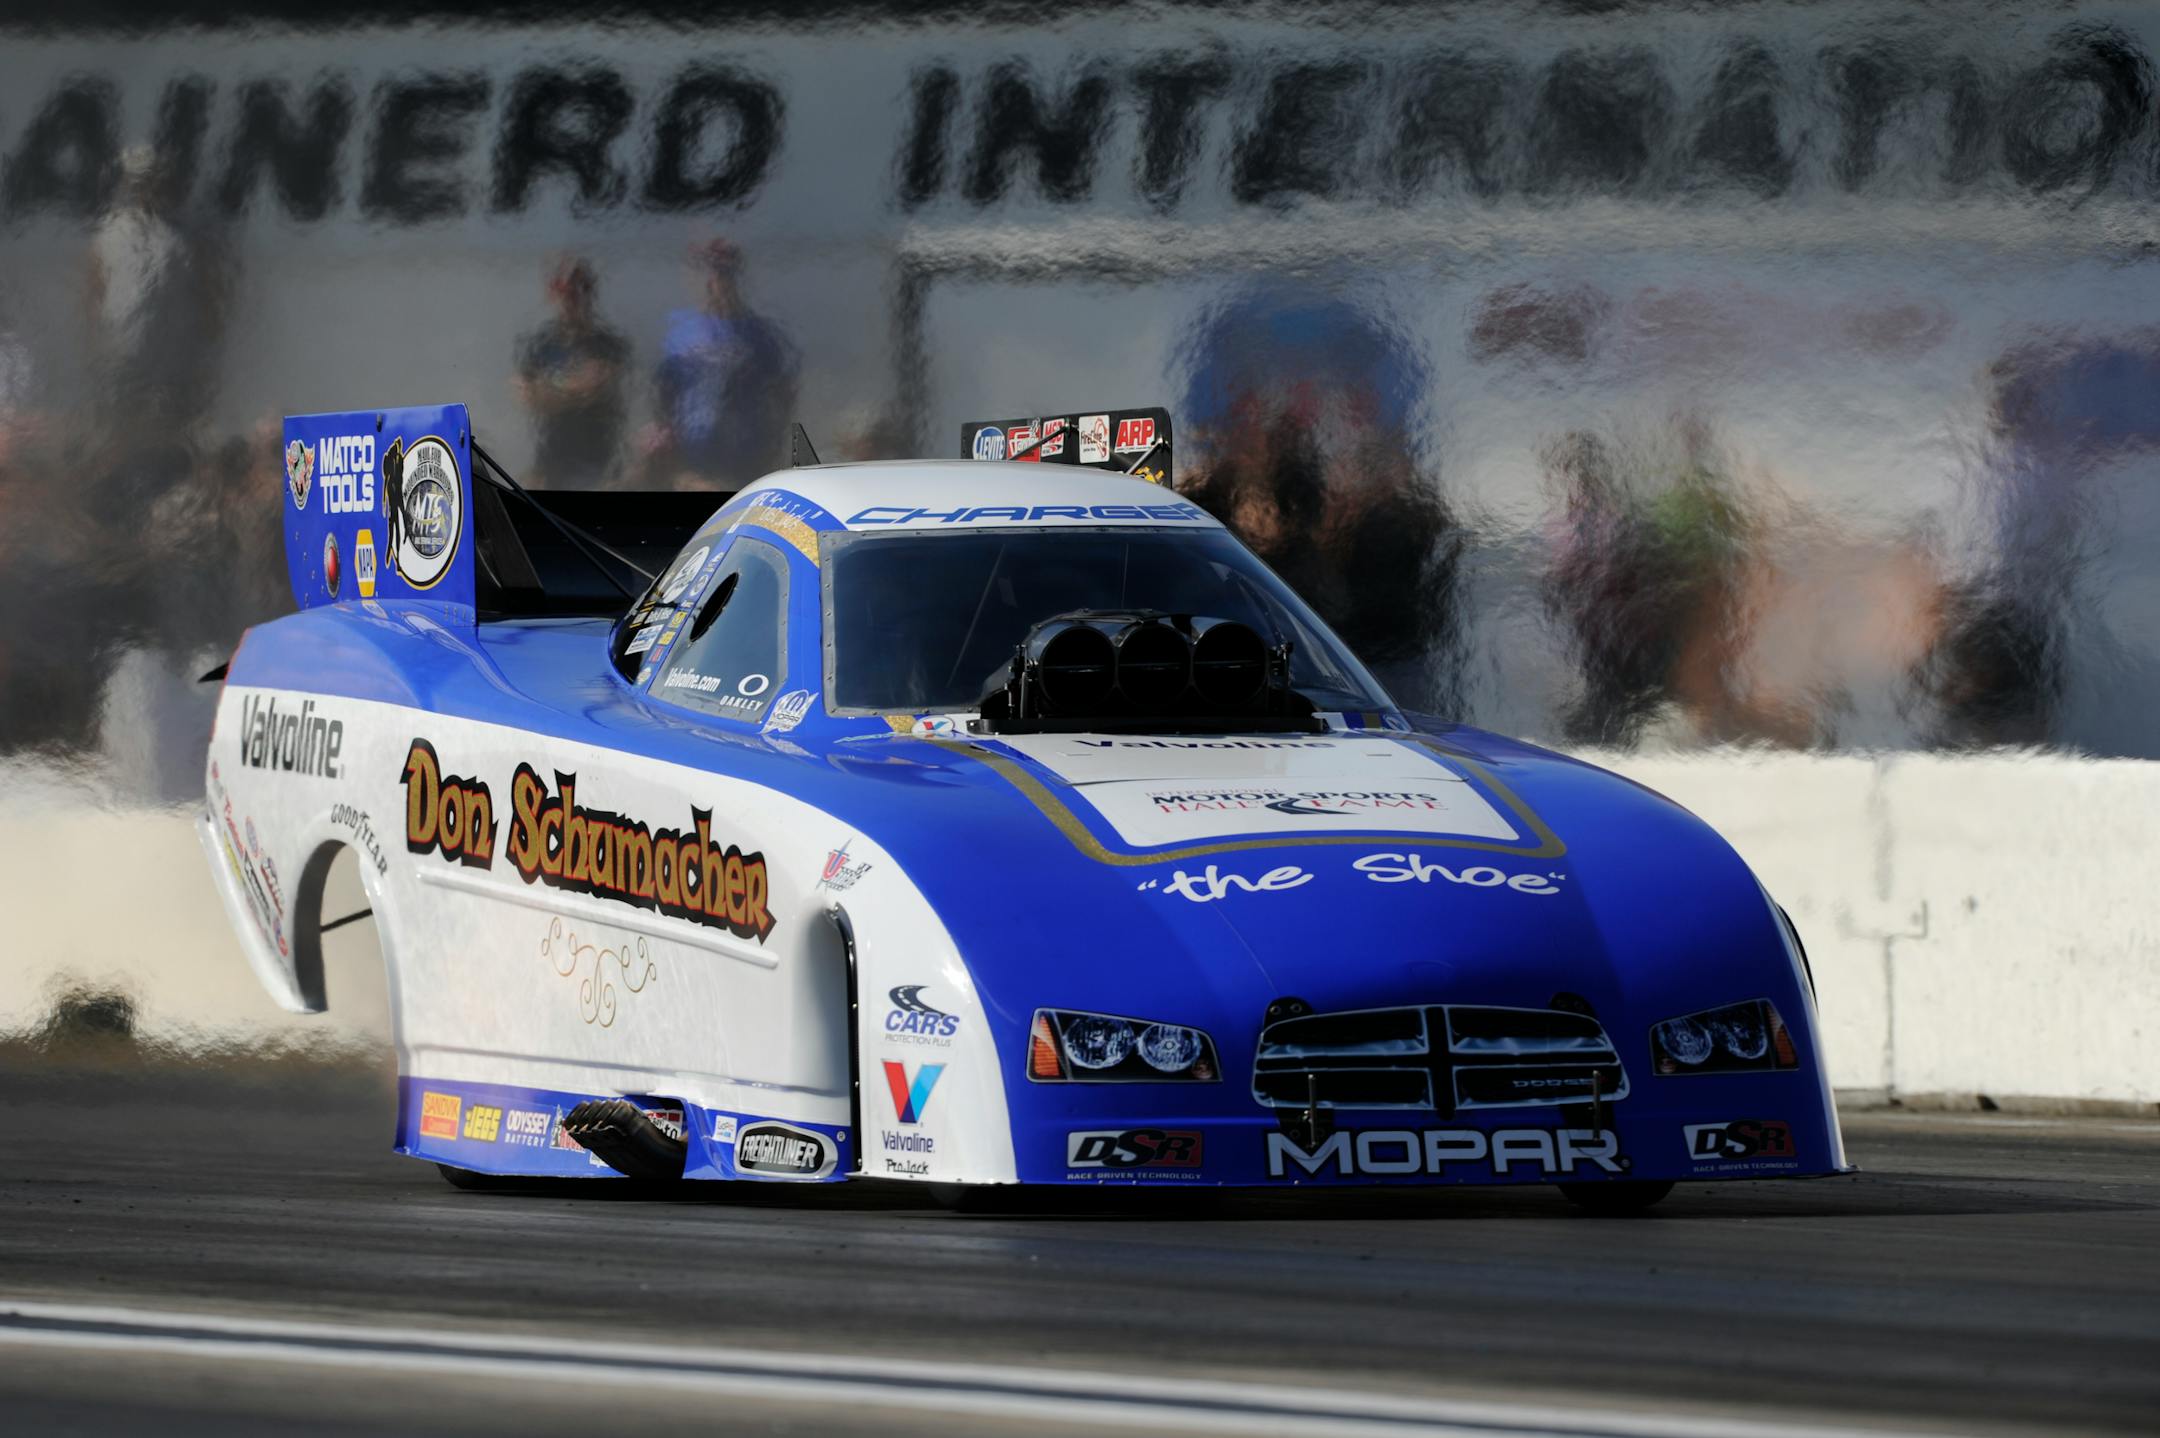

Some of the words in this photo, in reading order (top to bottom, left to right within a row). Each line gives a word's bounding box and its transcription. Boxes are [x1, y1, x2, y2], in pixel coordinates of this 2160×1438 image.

[1116, 419, 1155, 447] ARP
[320, 434, 375, 475] MATCO
[320, 473, 375, 514] TOOLS
[664, 667, 721, 692] Valvoline.com
[719, 695, 763, 711] OAKLEY
[242, 694, 344, 779] Valvoline
[1072, 739, 1337, 750] Valvoline
[399, 737, 498, 871] Don
[1160, 800, 1258, 814] HALL
[506, 1109, 551, 1136] ODYSSEY
[504, 1132, 546, 1148] BATTERY
[741, 1134, 818, 1168] FREIGHTLINER
[882, 1130, 934, 1153] Valvoline
[1073, 1129, 1195, 1168] DSR
[1266, 1130, 1623, 1178] MOPAR
[1694, 1120, 1788, 1160] DSR
